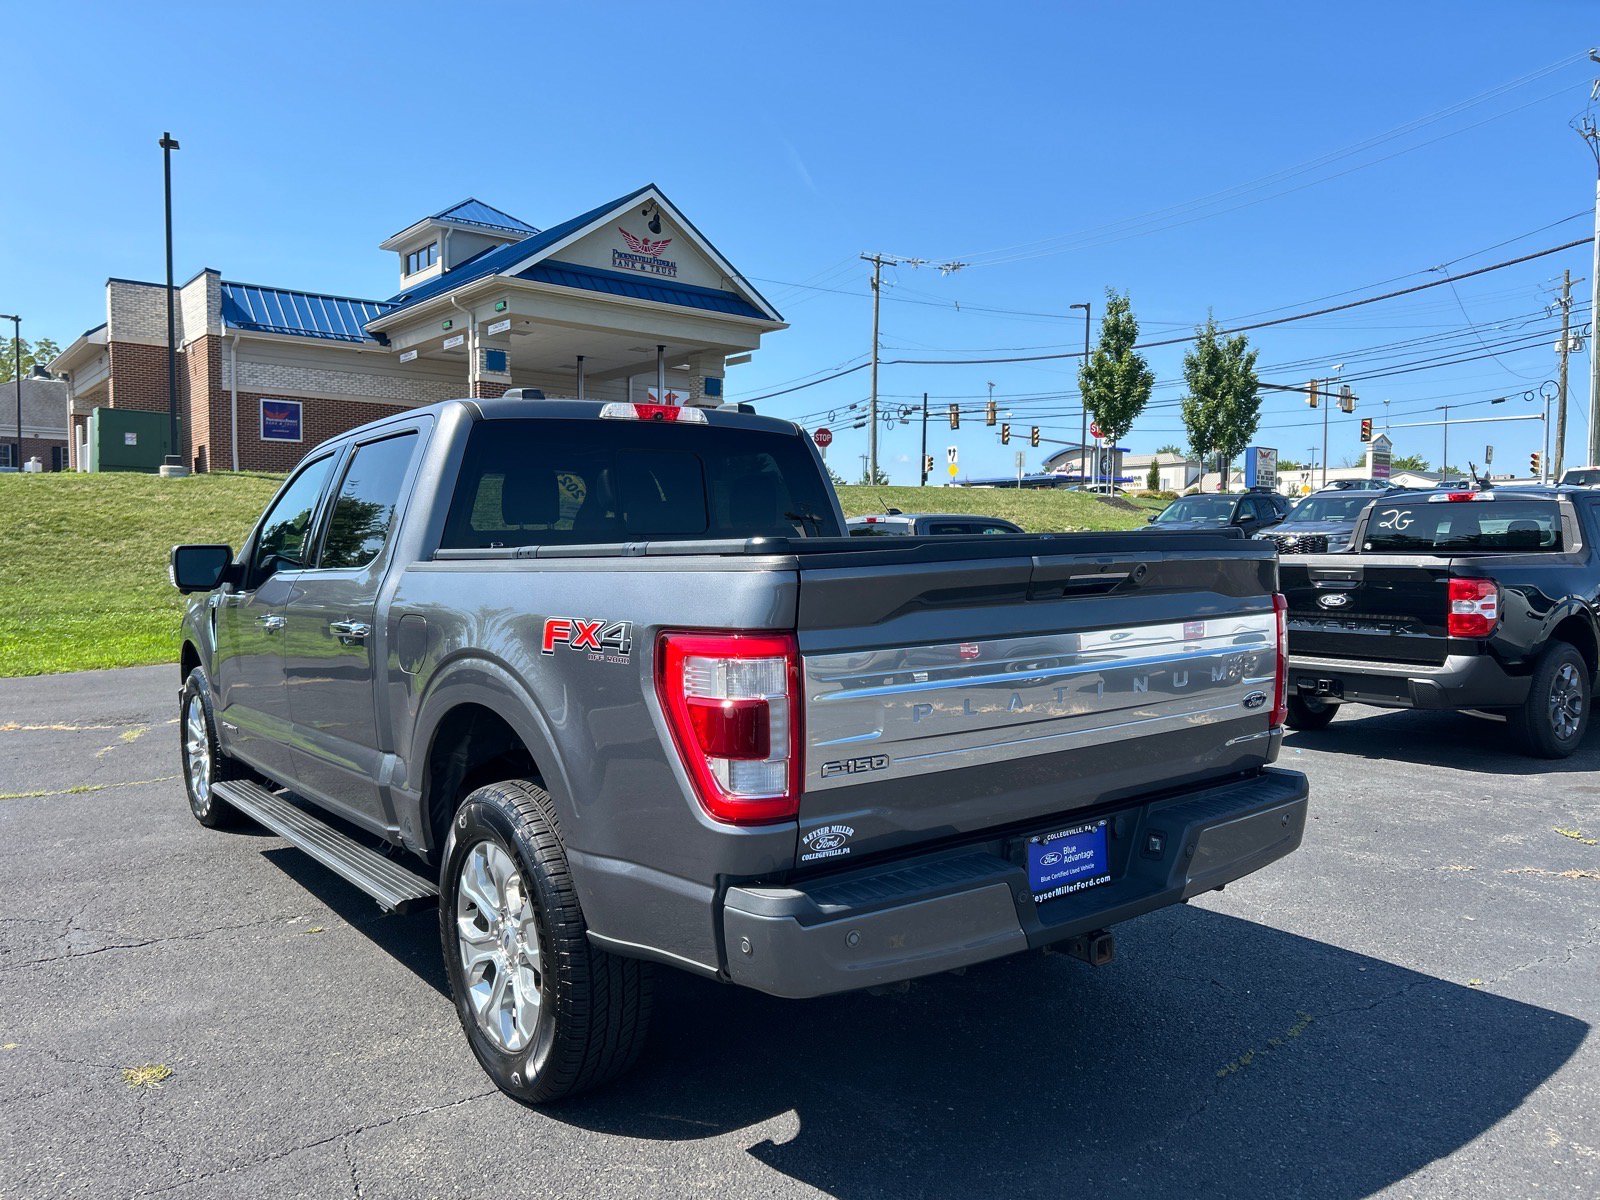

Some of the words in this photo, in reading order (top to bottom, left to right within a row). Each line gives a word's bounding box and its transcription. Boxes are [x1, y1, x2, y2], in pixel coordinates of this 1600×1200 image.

[612, 258, 636, 269] BANK
[650, 265, 677, 276] TRUST
[814, 433, 832, 442] STOP
[541, 616, 633, 656] FX4
[912, 665, 1228, 723] PLATINUM
[821, 754, 889, 778] F-150
[802, 825, 830, 844] KEYSER
[831, 825, 855, 837] MILLER
[816, 835, 840, 849] Ford
[1063, 845, 1077, 855] Blue
[1063, 850, 1094, 864] Advantage
[1033, 875, 1111, 902] eyserMillerFord.com
